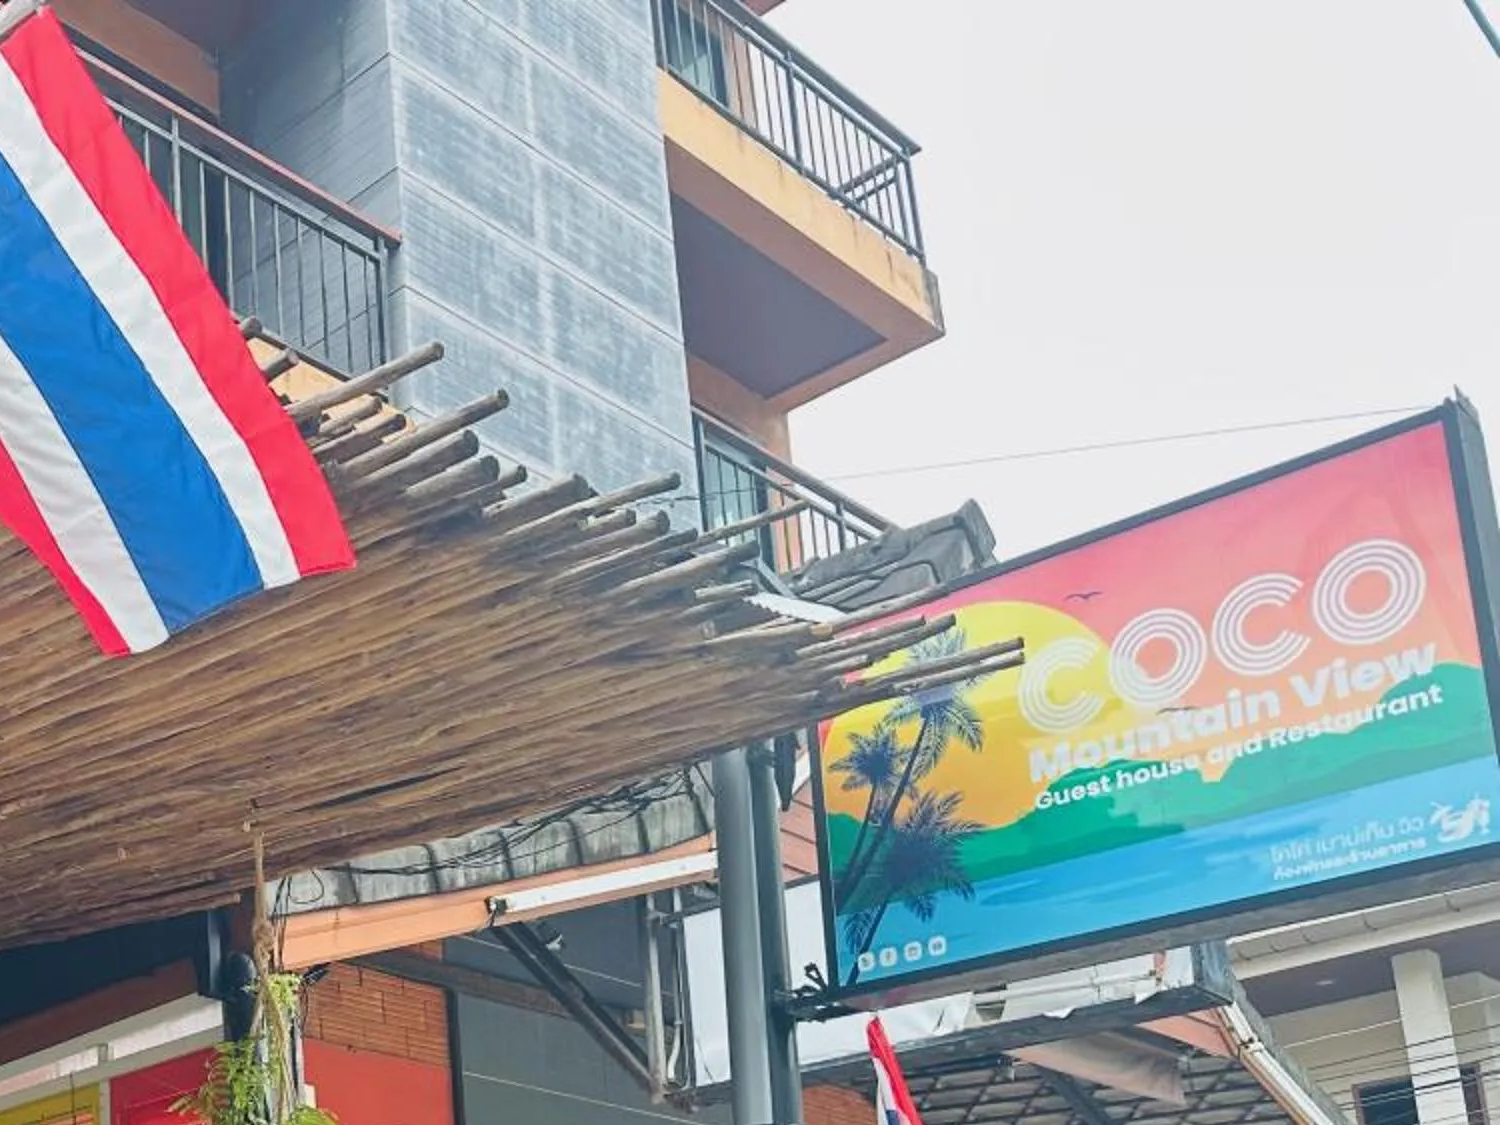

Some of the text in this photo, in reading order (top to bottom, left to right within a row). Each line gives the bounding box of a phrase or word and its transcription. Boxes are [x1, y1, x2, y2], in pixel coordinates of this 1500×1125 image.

[1016, 538, 1428, 735] COCO
[1028, 640, 1440, 784] Mountain View
[1034, 683, 1444, 810] Guest house and Restaurant
